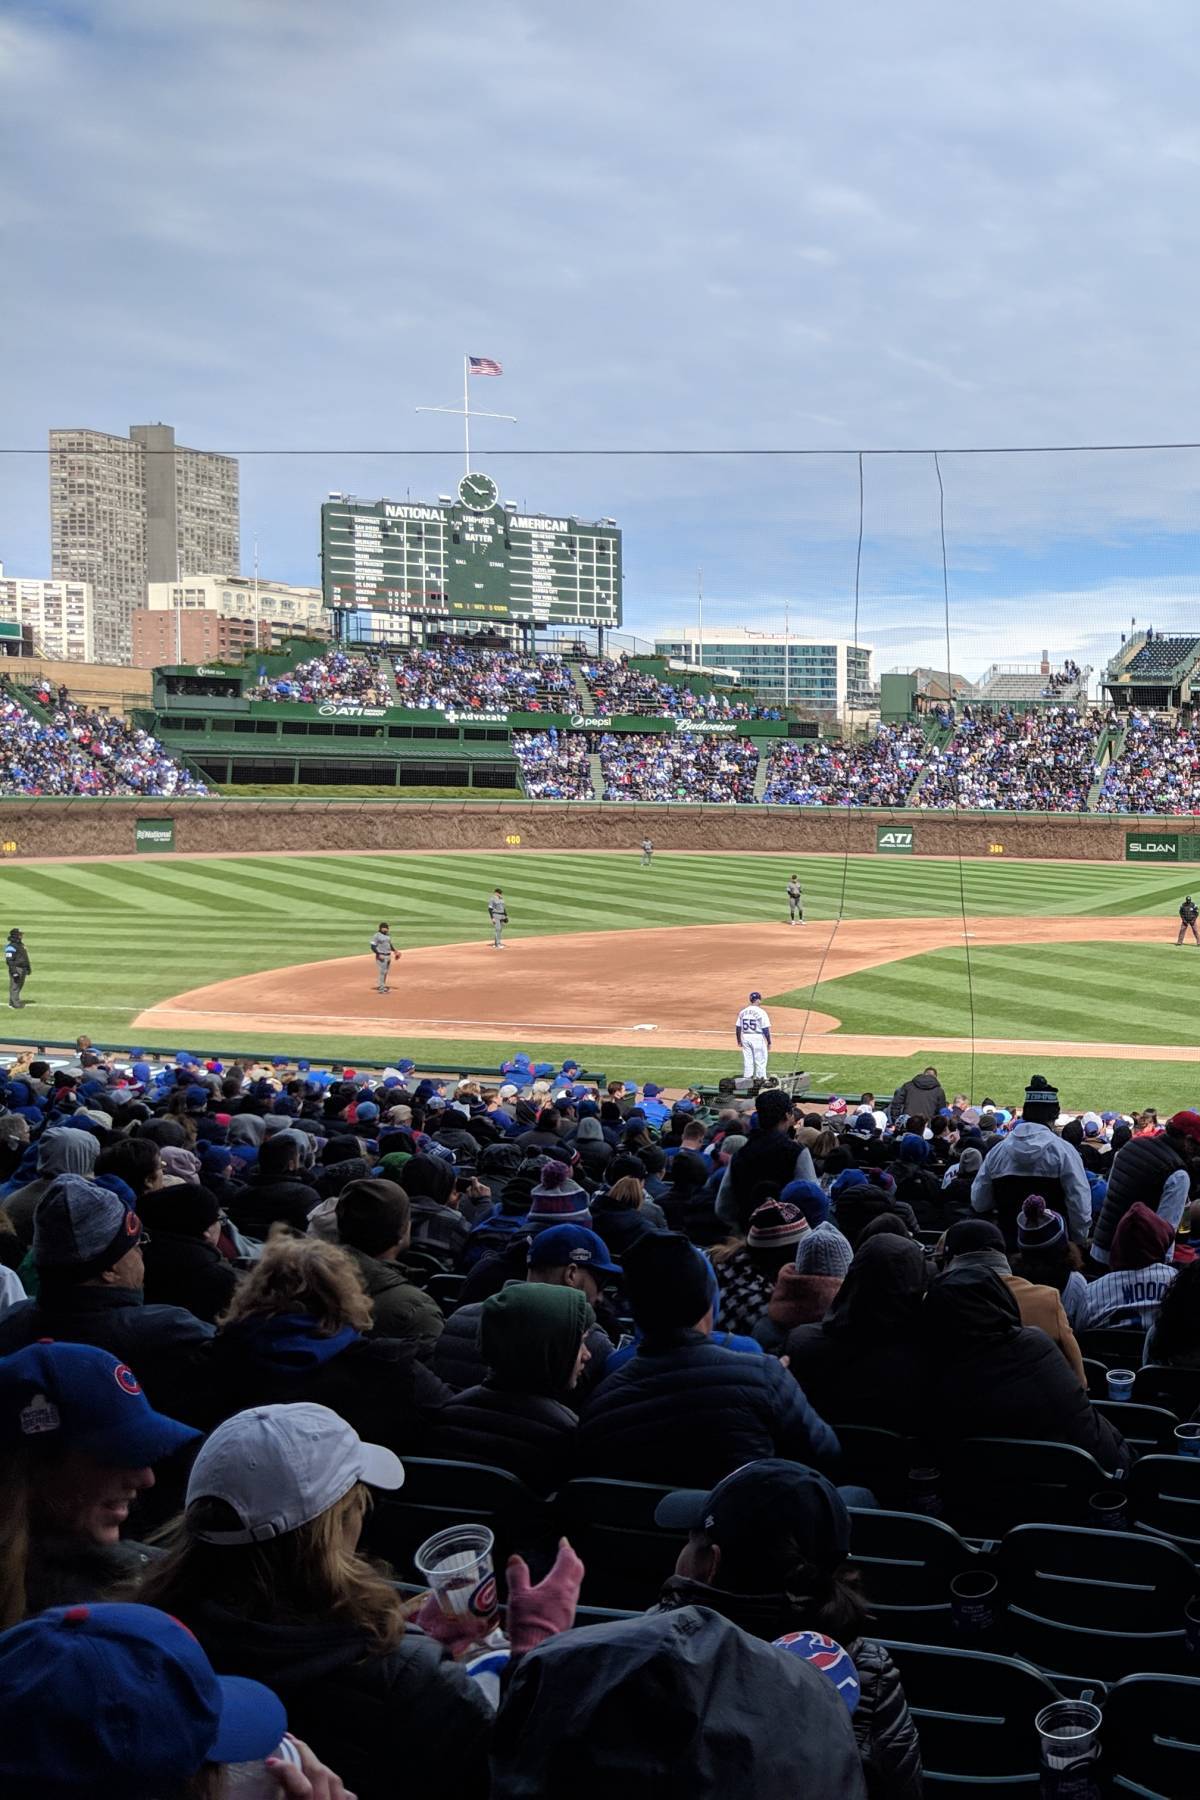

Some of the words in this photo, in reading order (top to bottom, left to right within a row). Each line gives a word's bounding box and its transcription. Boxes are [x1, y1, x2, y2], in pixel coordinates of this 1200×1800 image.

[385, 505, 447, 522] NATIONAL
[462, 515, 495, 525] UMPIRES
[509, 516, 568, 532] AMERICAN
[465, 533, 492, 543] BATTER
[336, 707, 363, 716] ATI
[460, 712, 508, 722] Advocate
[585, 717, 612, 727] pepsi
[675, 718, 737, 732] Budweiser
[506, 835, 520, 844] 400
[880, 833, 912, 843] ATI
[1129, 843, 1176, 853] SLOAN
[742, 1019, 757, 1031] 55
